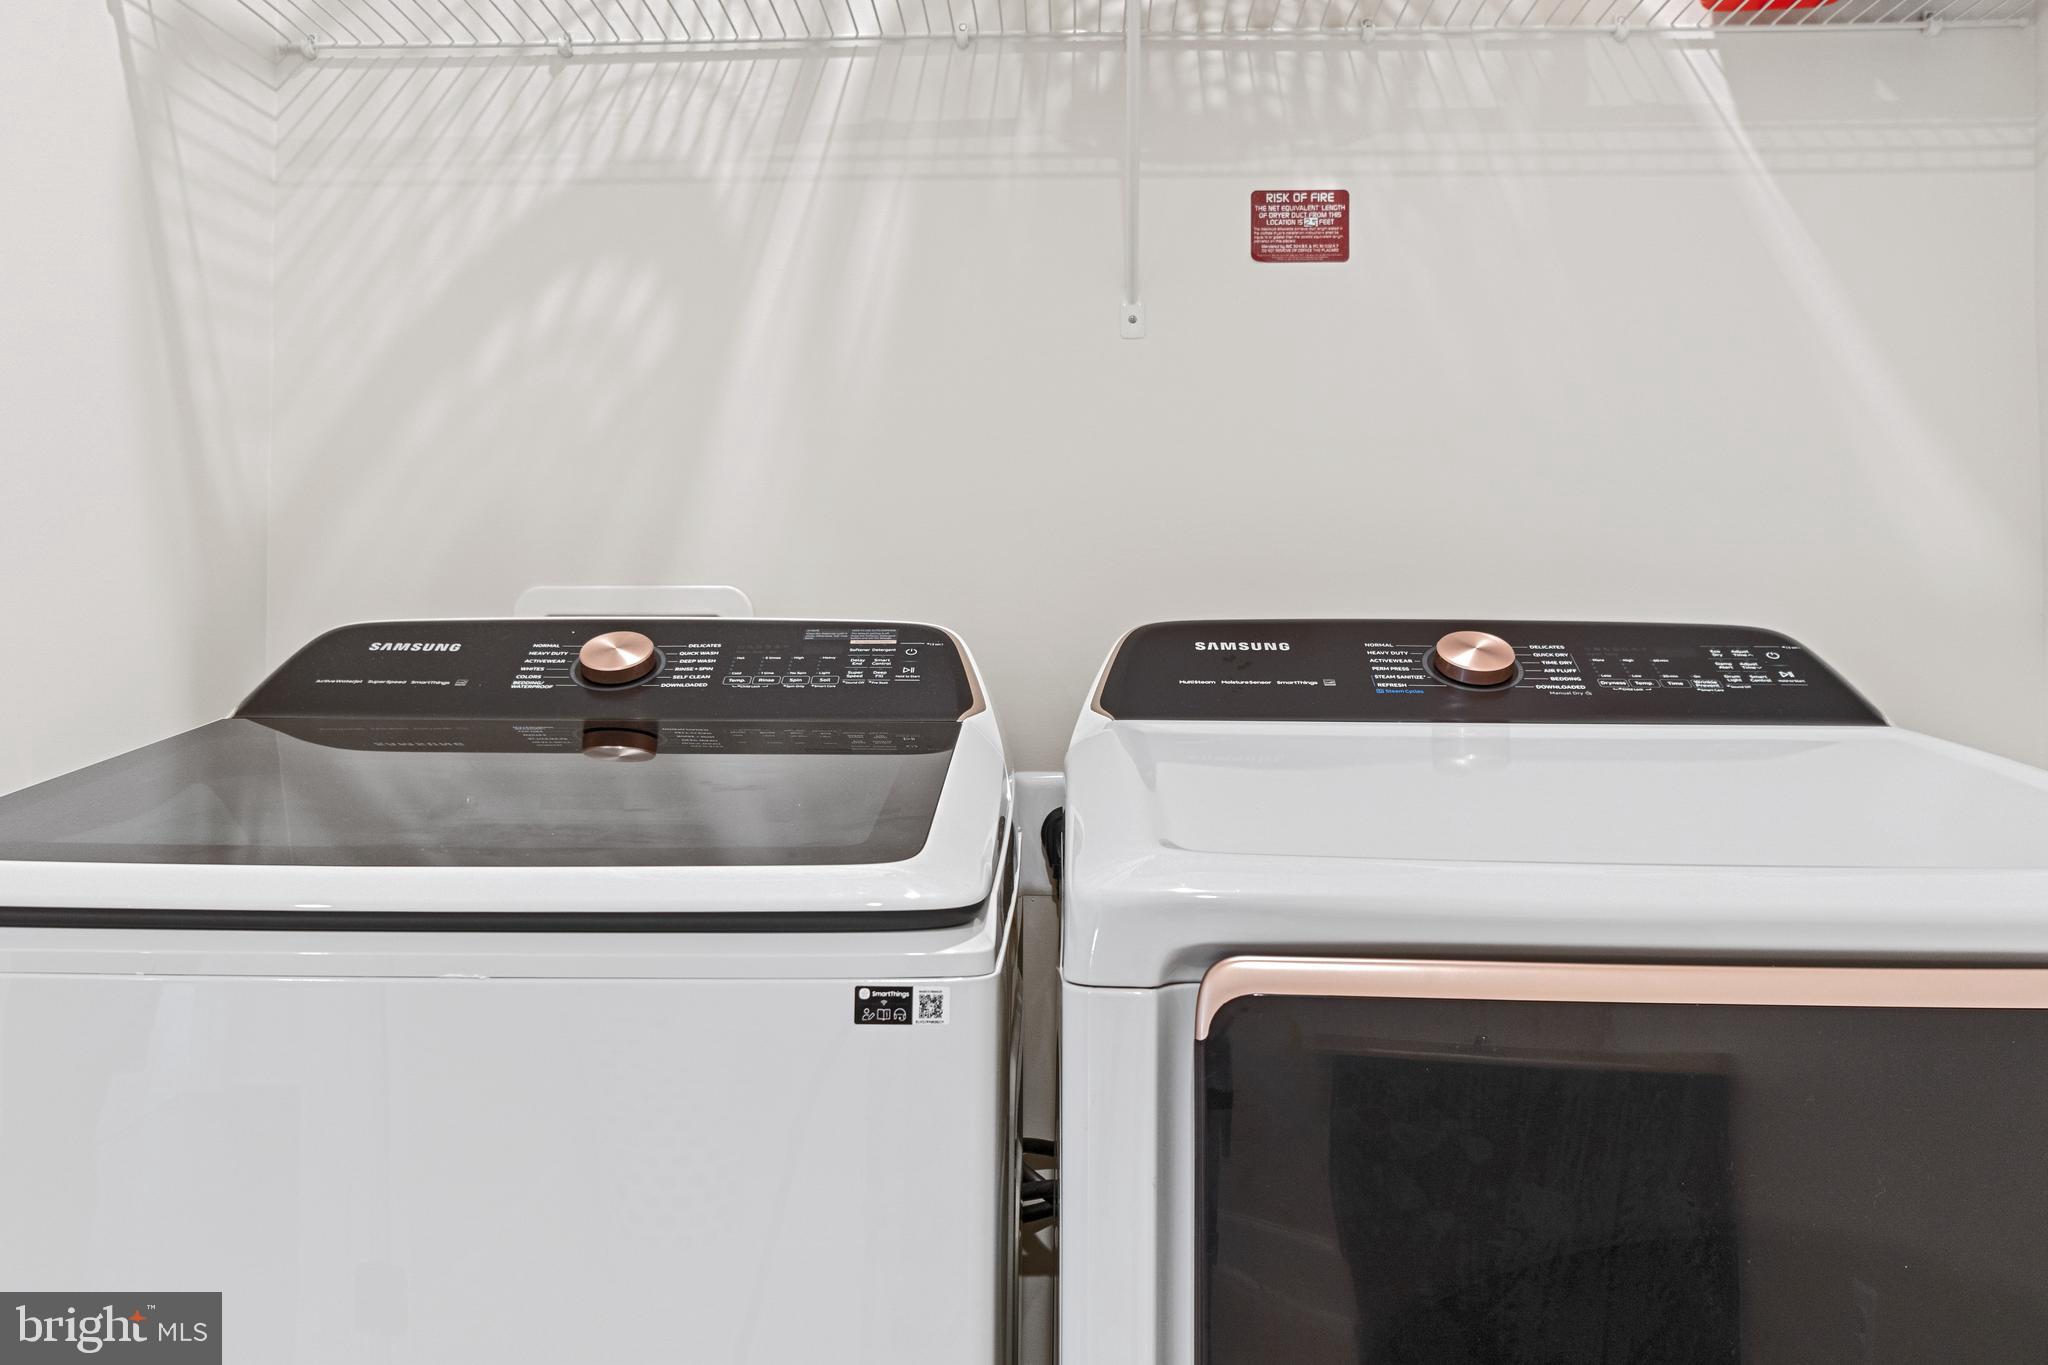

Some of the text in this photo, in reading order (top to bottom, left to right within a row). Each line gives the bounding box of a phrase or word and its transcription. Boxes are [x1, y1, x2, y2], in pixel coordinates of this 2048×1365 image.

[1266, 192, 1334, 203] RISK OF FIRE
[368, 642, 462, 652] SAMSUNG
[1194, 642, 1290, 651] SAMSUNG
[872, 991, 910, 999] SmartThings
